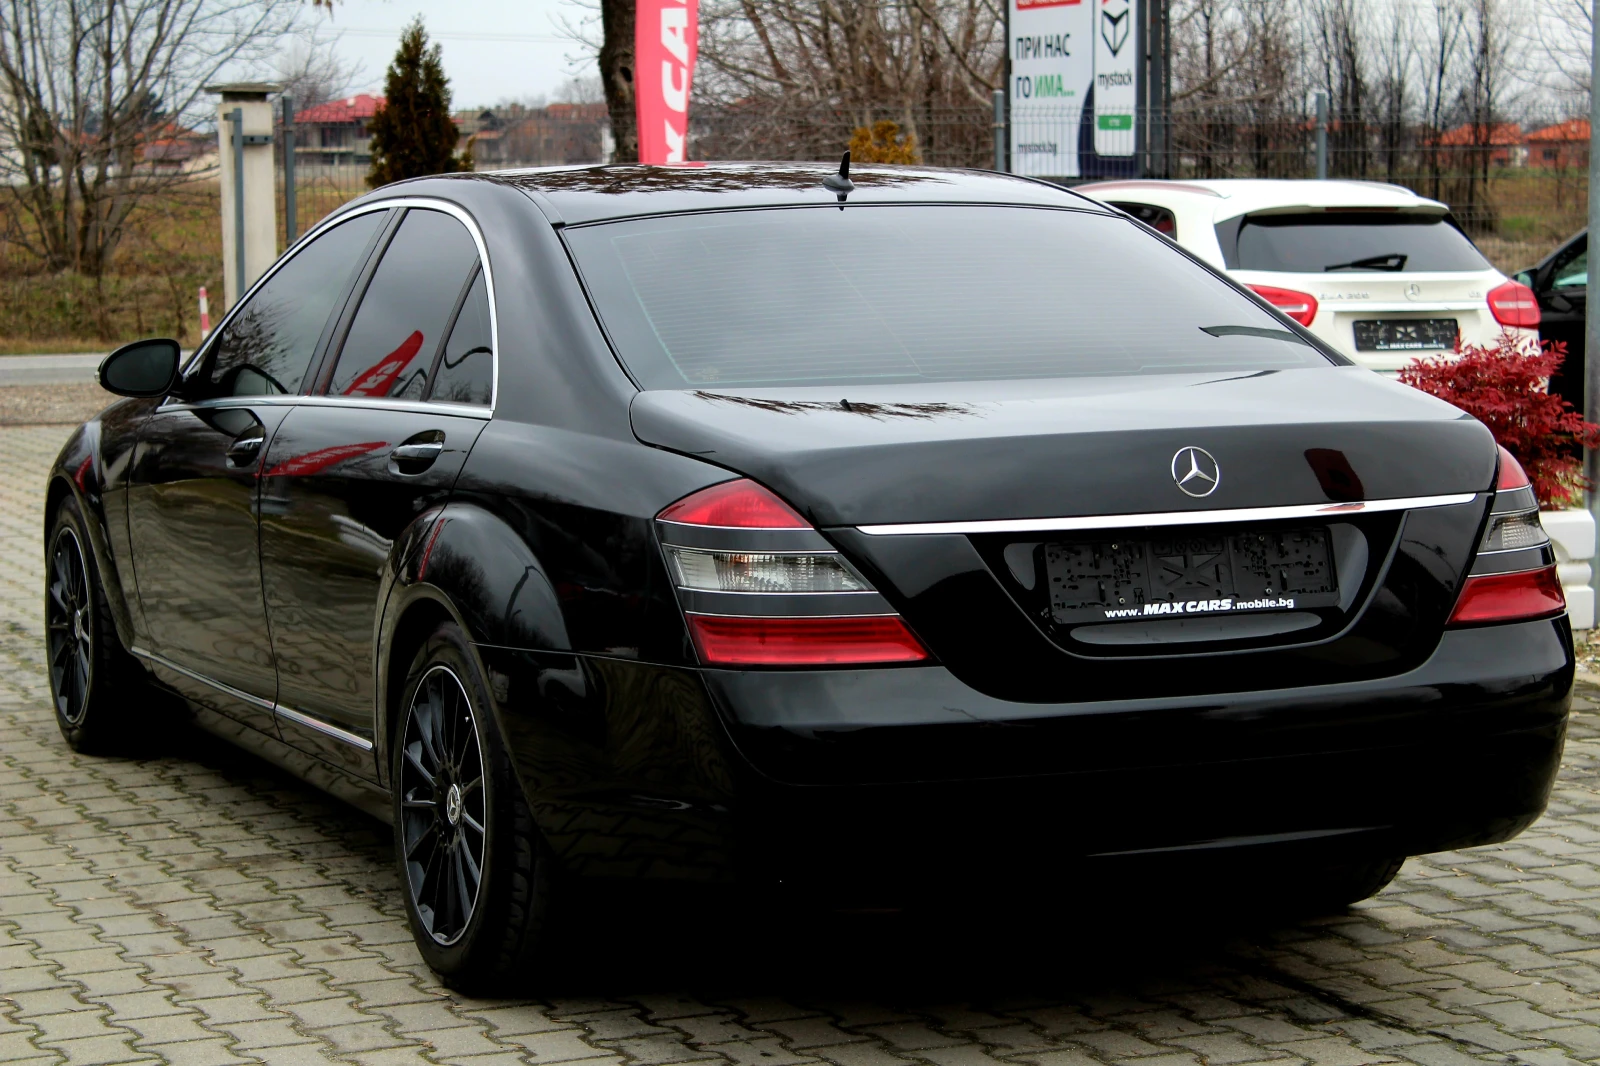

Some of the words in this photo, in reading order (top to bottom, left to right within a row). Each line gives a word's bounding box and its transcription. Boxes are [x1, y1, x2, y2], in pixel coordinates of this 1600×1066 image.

[660, 0, 689, 113] CA
[1016, 37, 1041, 60] ПРИ
[1044, 33, 1071, 58] НАС
[1016, 76, 1032, 99] ГО
[1097, 69, 1133, 91] mystack
